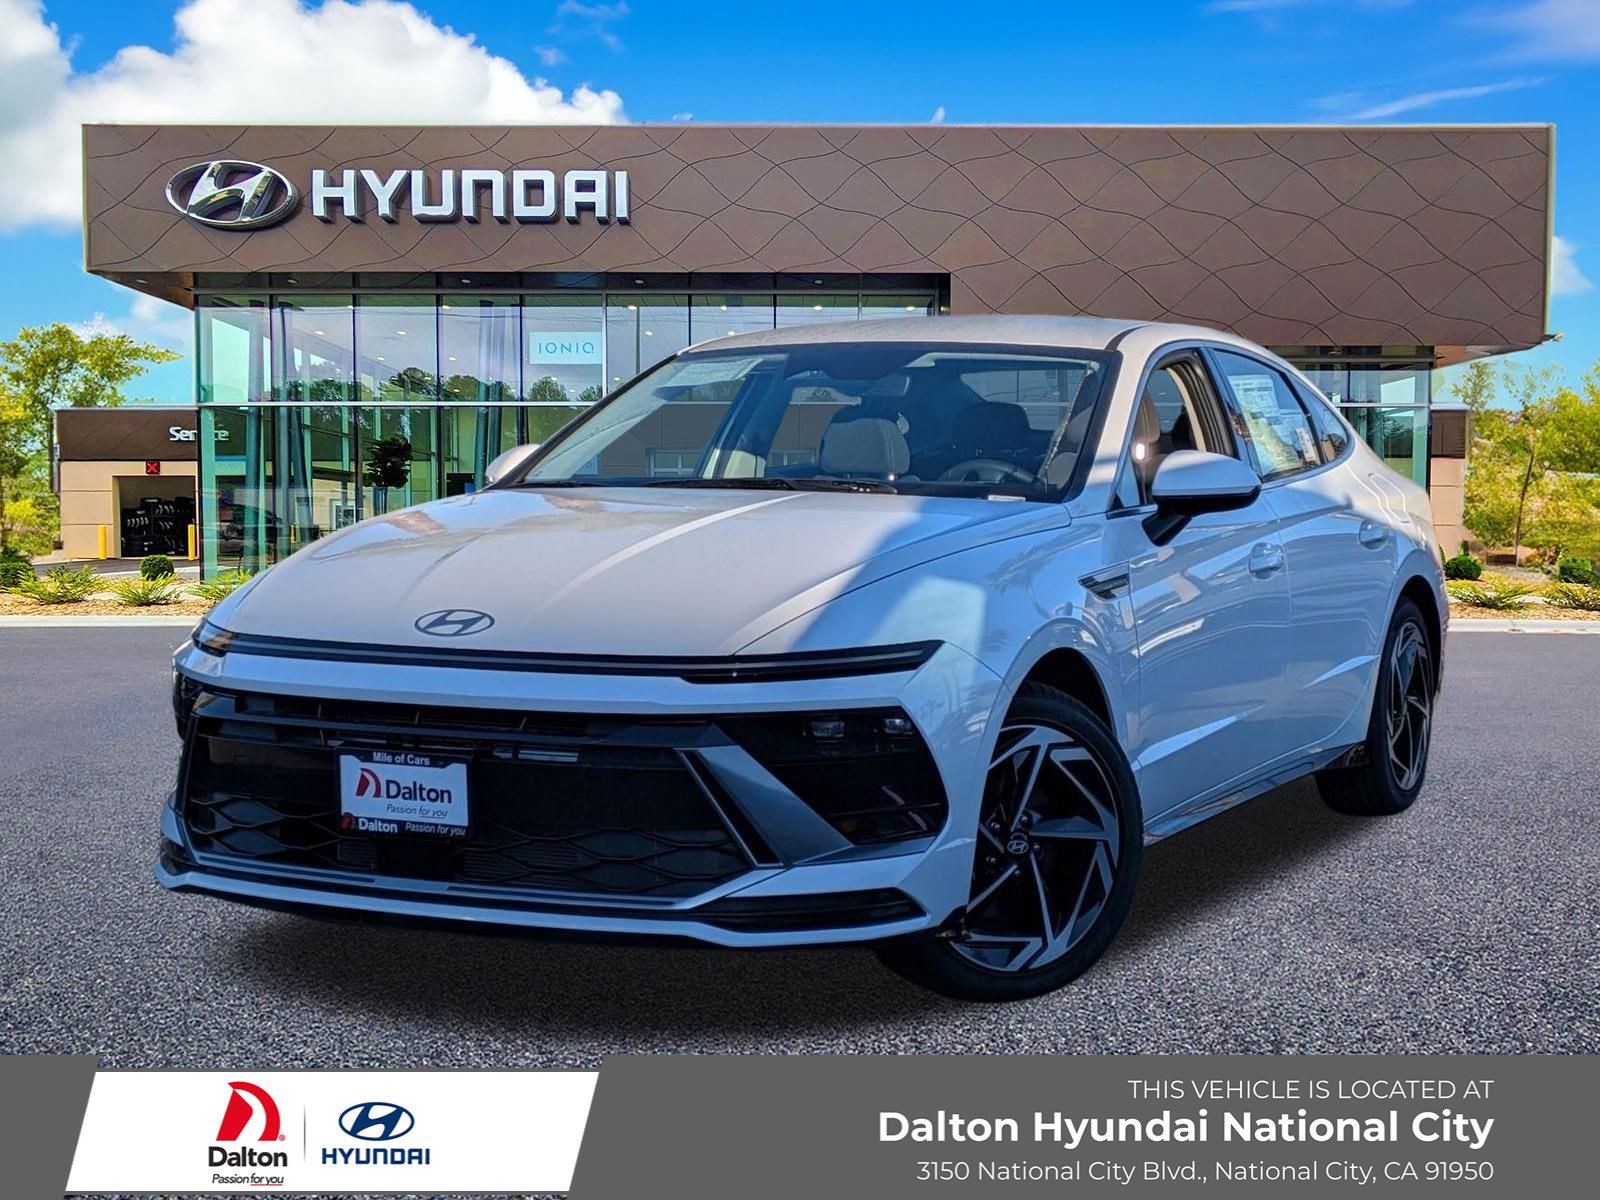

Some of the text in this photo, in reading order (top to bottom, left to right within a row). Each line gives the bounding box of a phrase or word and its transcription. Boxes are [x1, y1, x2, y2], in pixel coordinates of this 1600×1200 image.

[311, 168, 631, 224] HYUNDAI
[538, 341, 595, 355] IONIQ
[373, 751, 431, 766] Mile of Cars
[385, 779, 452, 803] Dalton
[386, 803, 448, 818] Passion for you
[358, 818, 398, 833] Dalton
[405, 821, 466, 836] Passion for you
